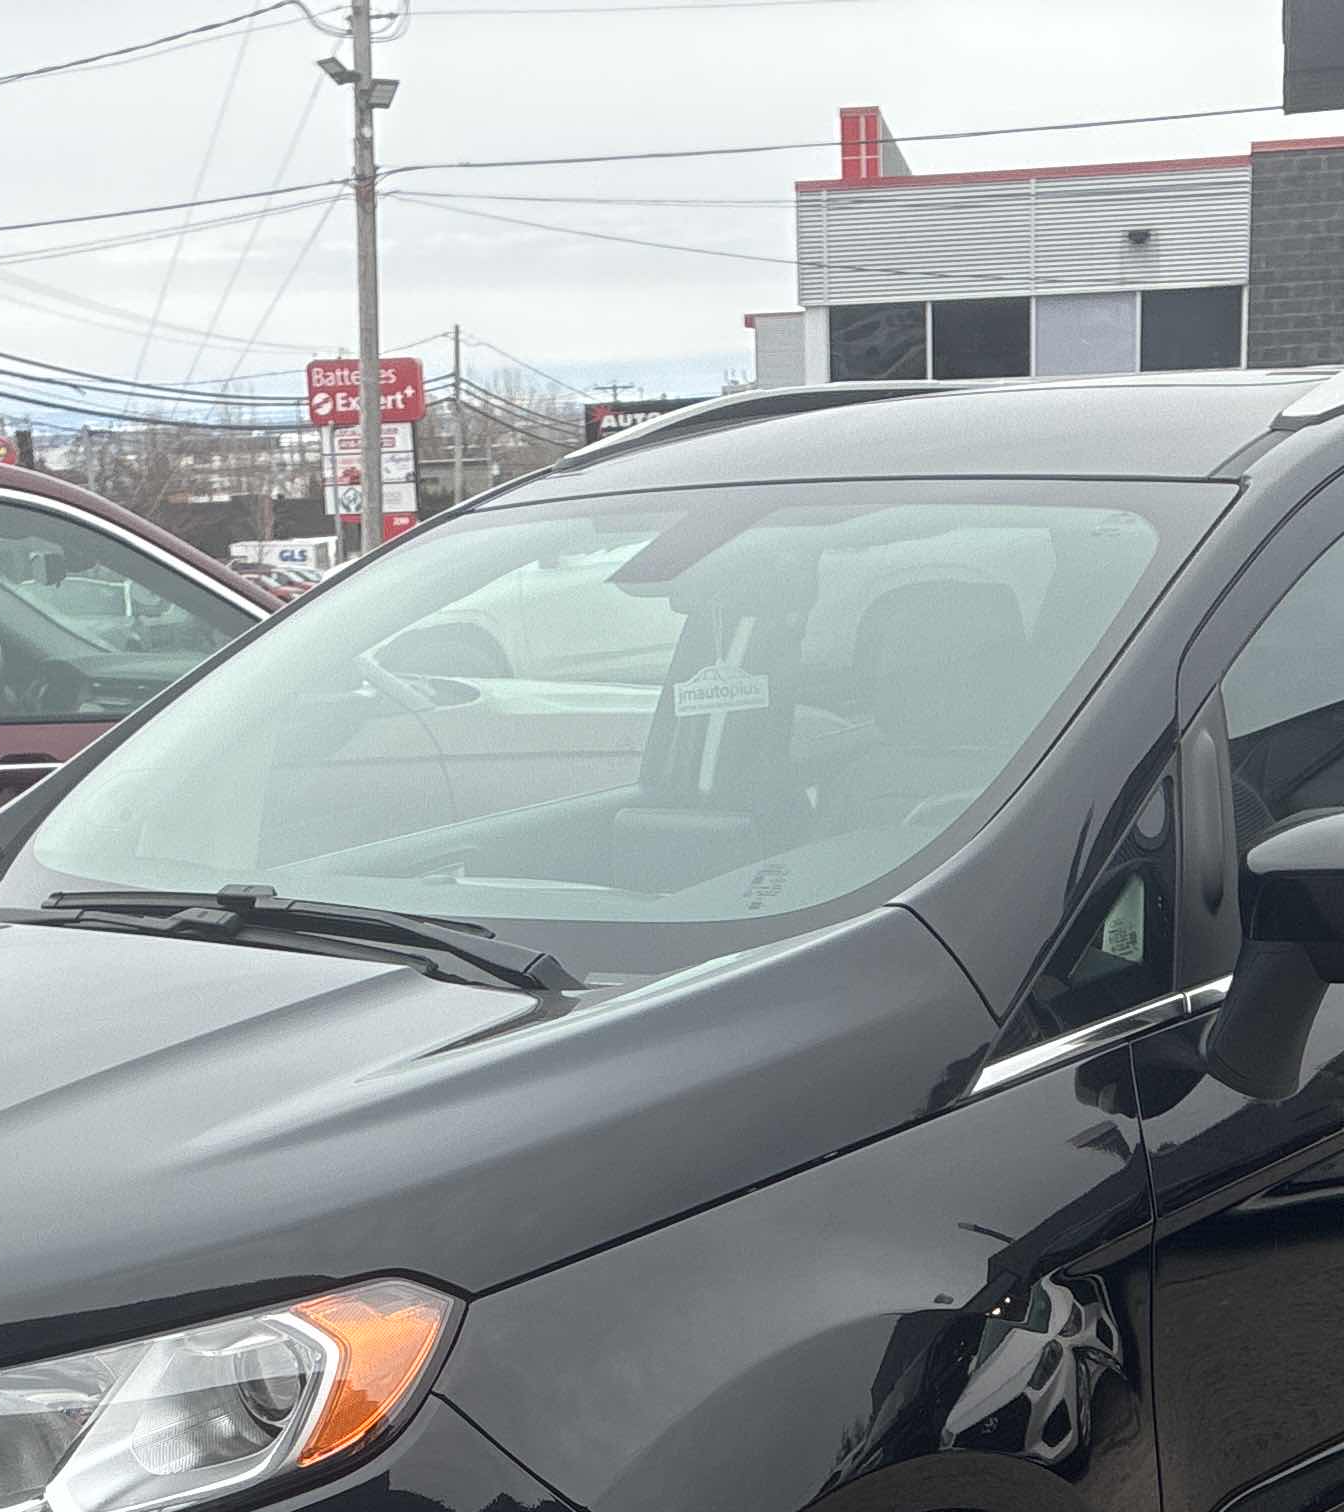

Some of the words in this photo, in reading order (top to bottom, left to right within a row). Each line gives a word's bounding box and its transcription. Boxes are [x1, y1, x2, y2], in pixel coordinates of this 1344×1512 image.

[312, 367, 397, 386] Battees
[600, 411, 662, 428] AUT
[279, 549, 307, 562] GLS
